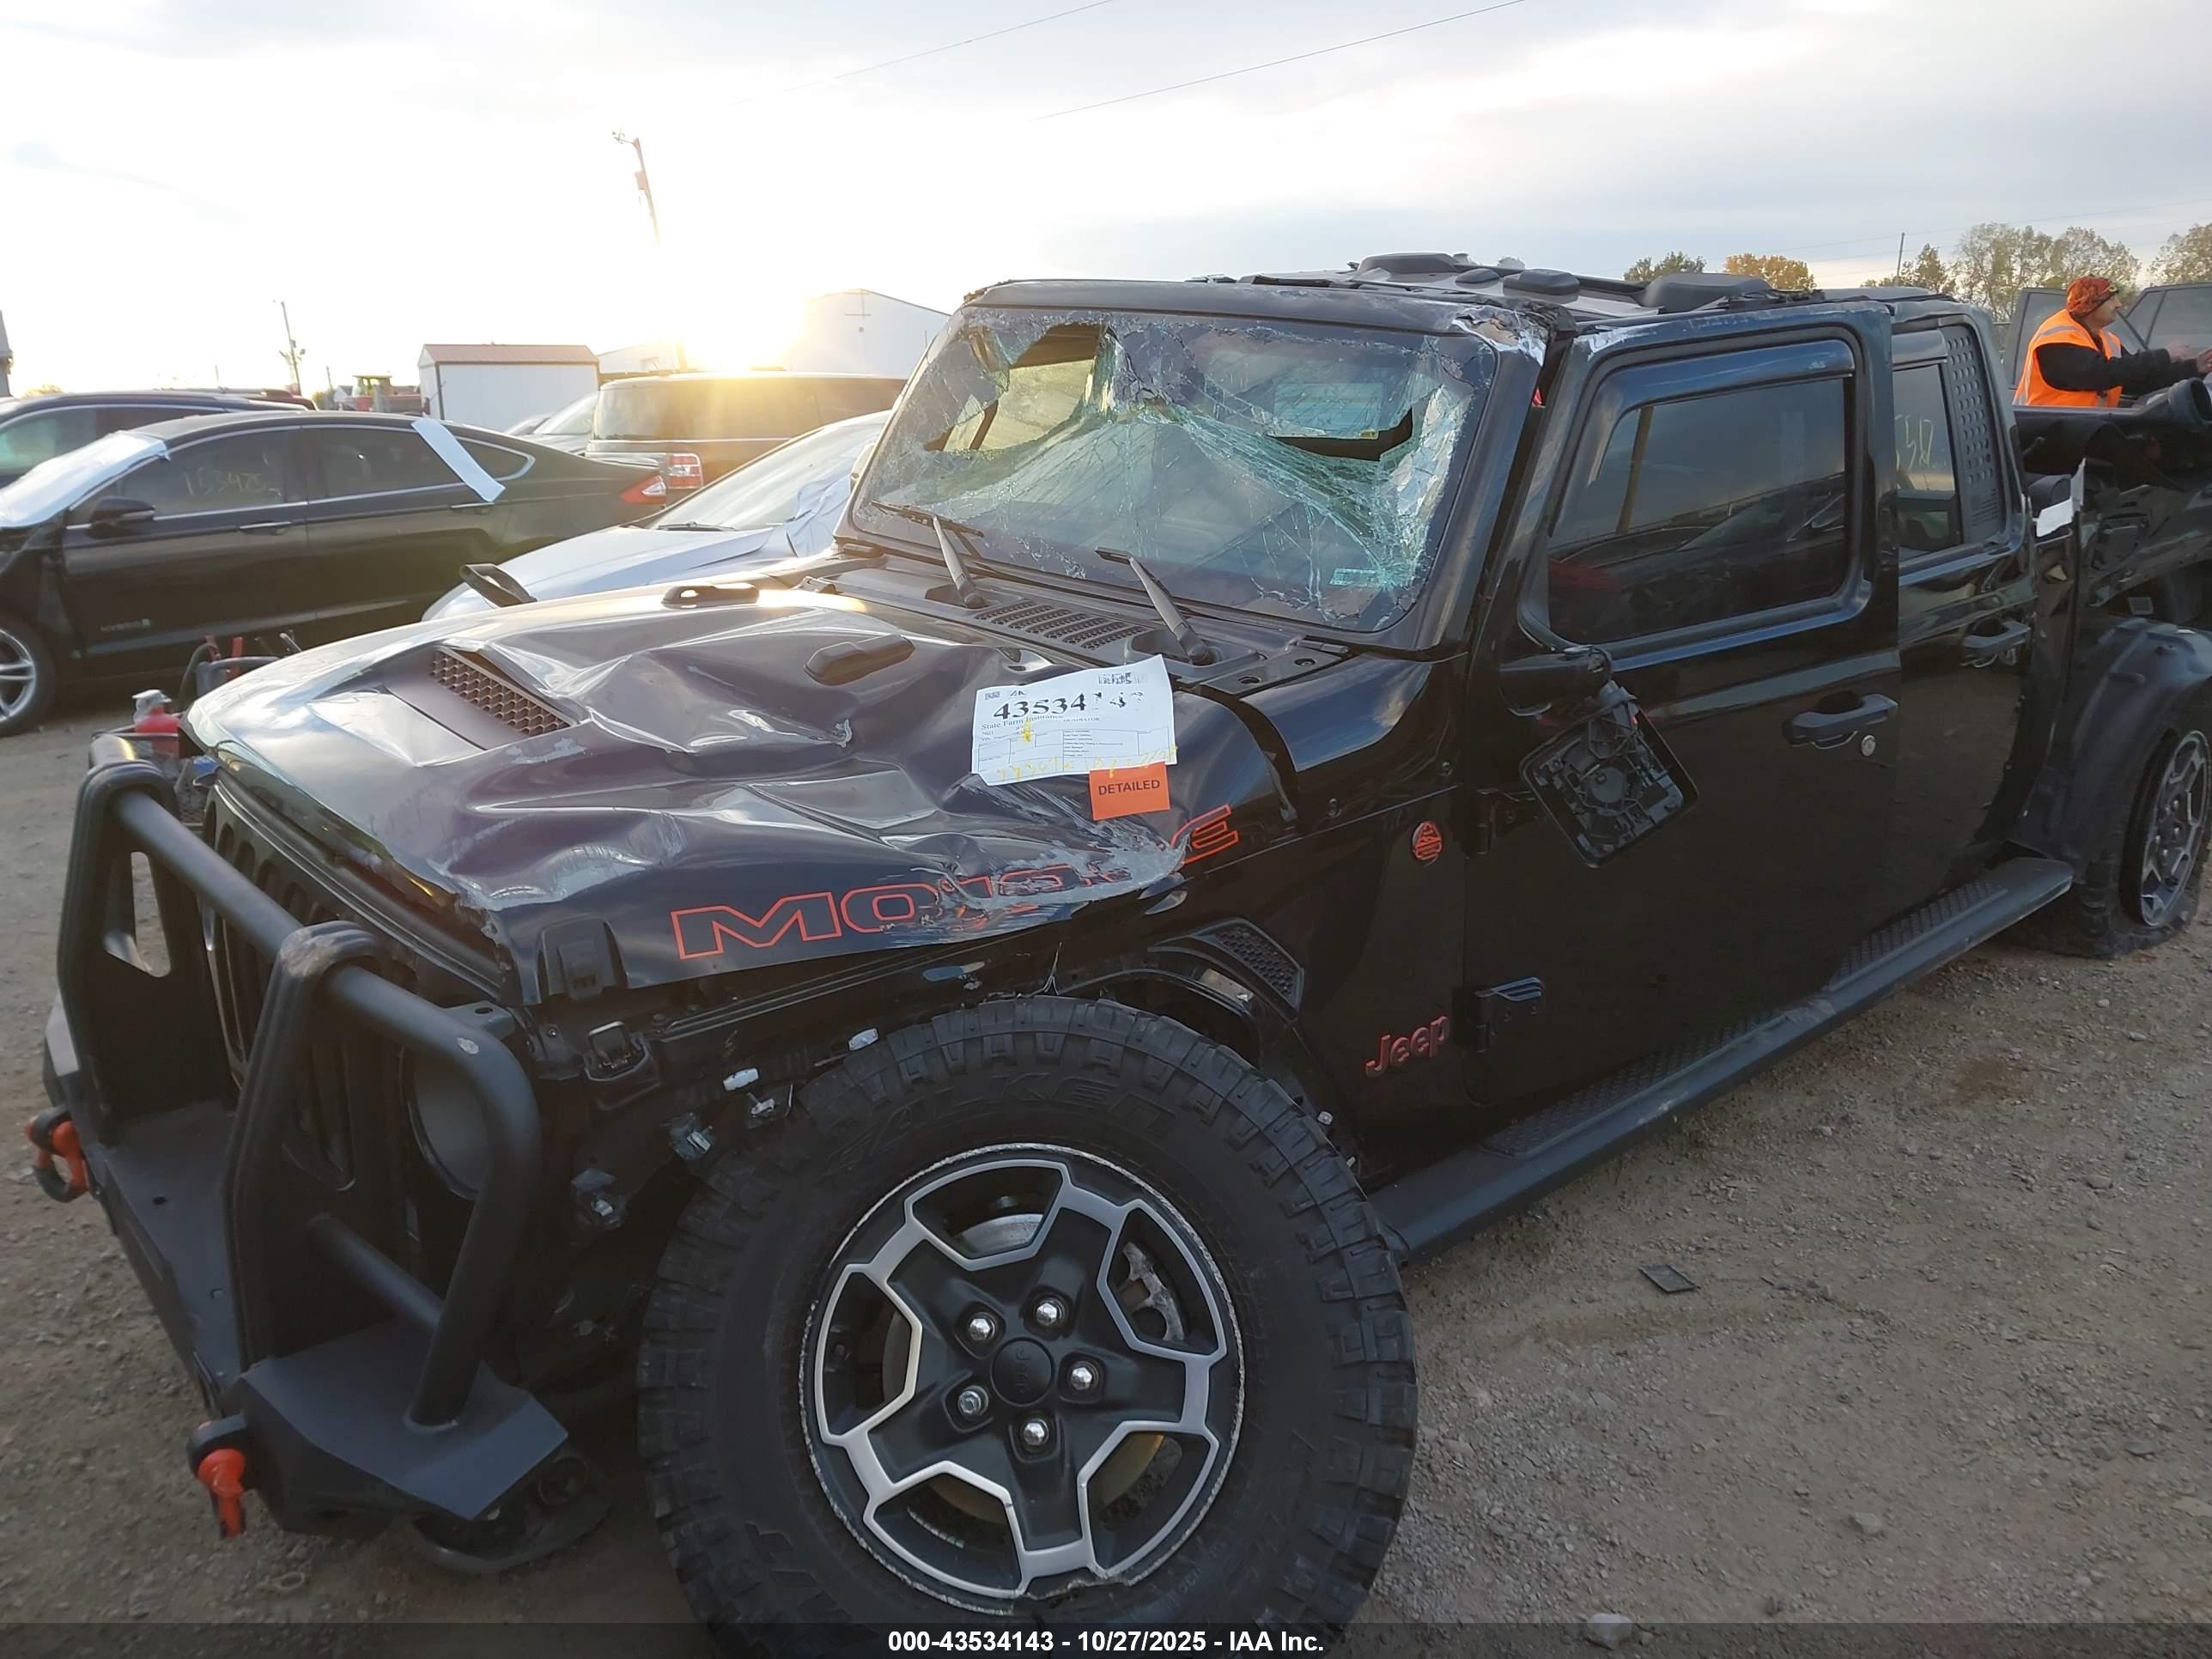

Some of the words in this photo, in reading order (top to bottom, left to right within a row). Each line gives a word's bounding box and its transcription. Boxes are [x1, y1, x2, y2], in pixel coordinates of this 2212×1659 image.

[994, 691, 1144, 720] 43534
[981, 722, 1001, 731] State
[1098, 779, 1160, 795] DETAILED
[670, 805, 1238, 960] MOJAE
[1365, 1015, 1450, 1079] Jeep
